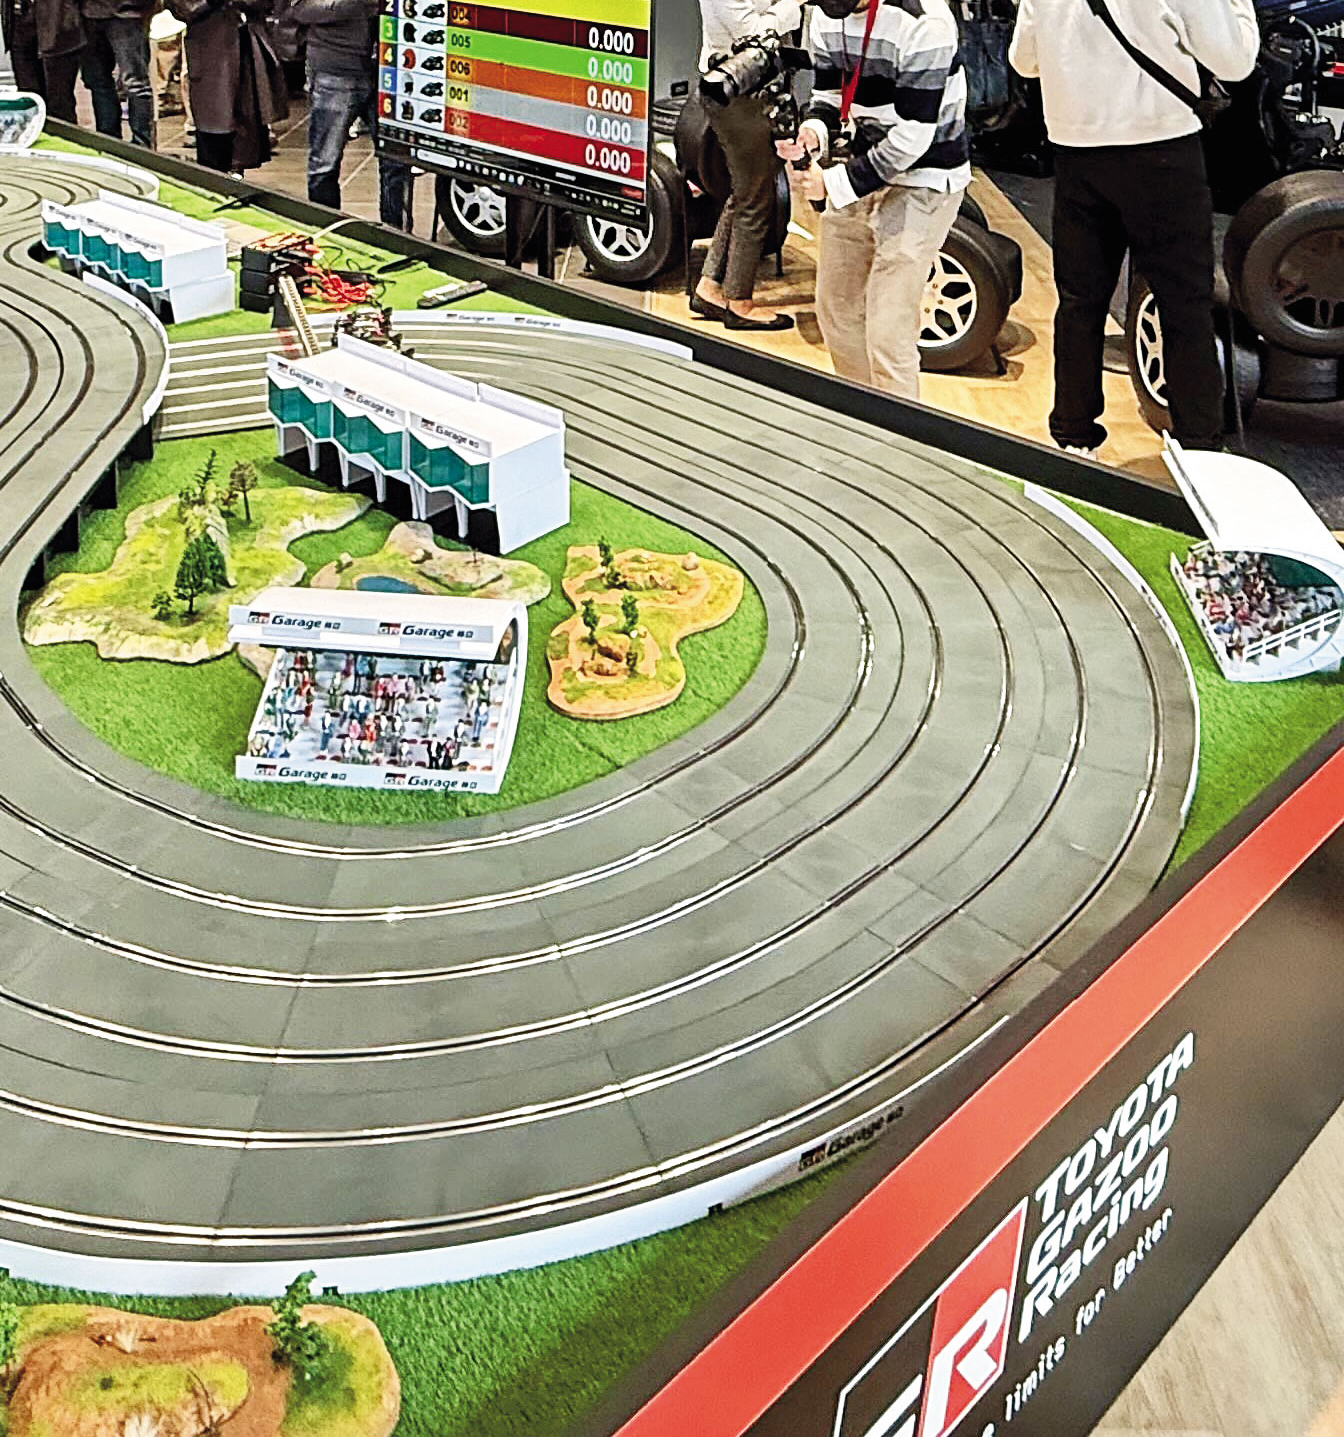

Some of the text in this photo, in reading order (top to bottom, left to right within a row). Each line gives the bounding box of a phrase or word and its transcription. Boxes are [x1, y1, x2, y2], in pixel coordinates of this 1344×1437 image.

[385, 22, 633, 83] 3 005 0.000
[588, 27, 634, 54] 0.000
[383, 47, 632, 114] 4 006 0.000
[383, 74, 631, 144] 5 001 0.000
[383, 99, 631, 173] 6 002 0.000
[271, 615, 322, 629] Garage
[402, 625, 454, 639] Garage
[278, 767, 328, 781] Garage
[408, 776, 458, 791] Garage
[1035, 1032, 1193, 1223] TOYOTA
[1026, 1094, 1177, 1285] GAZOO
[1018, 1147, 1169, 1343] Racing
[1005, 1208, 1173, 1421] limits for Better
